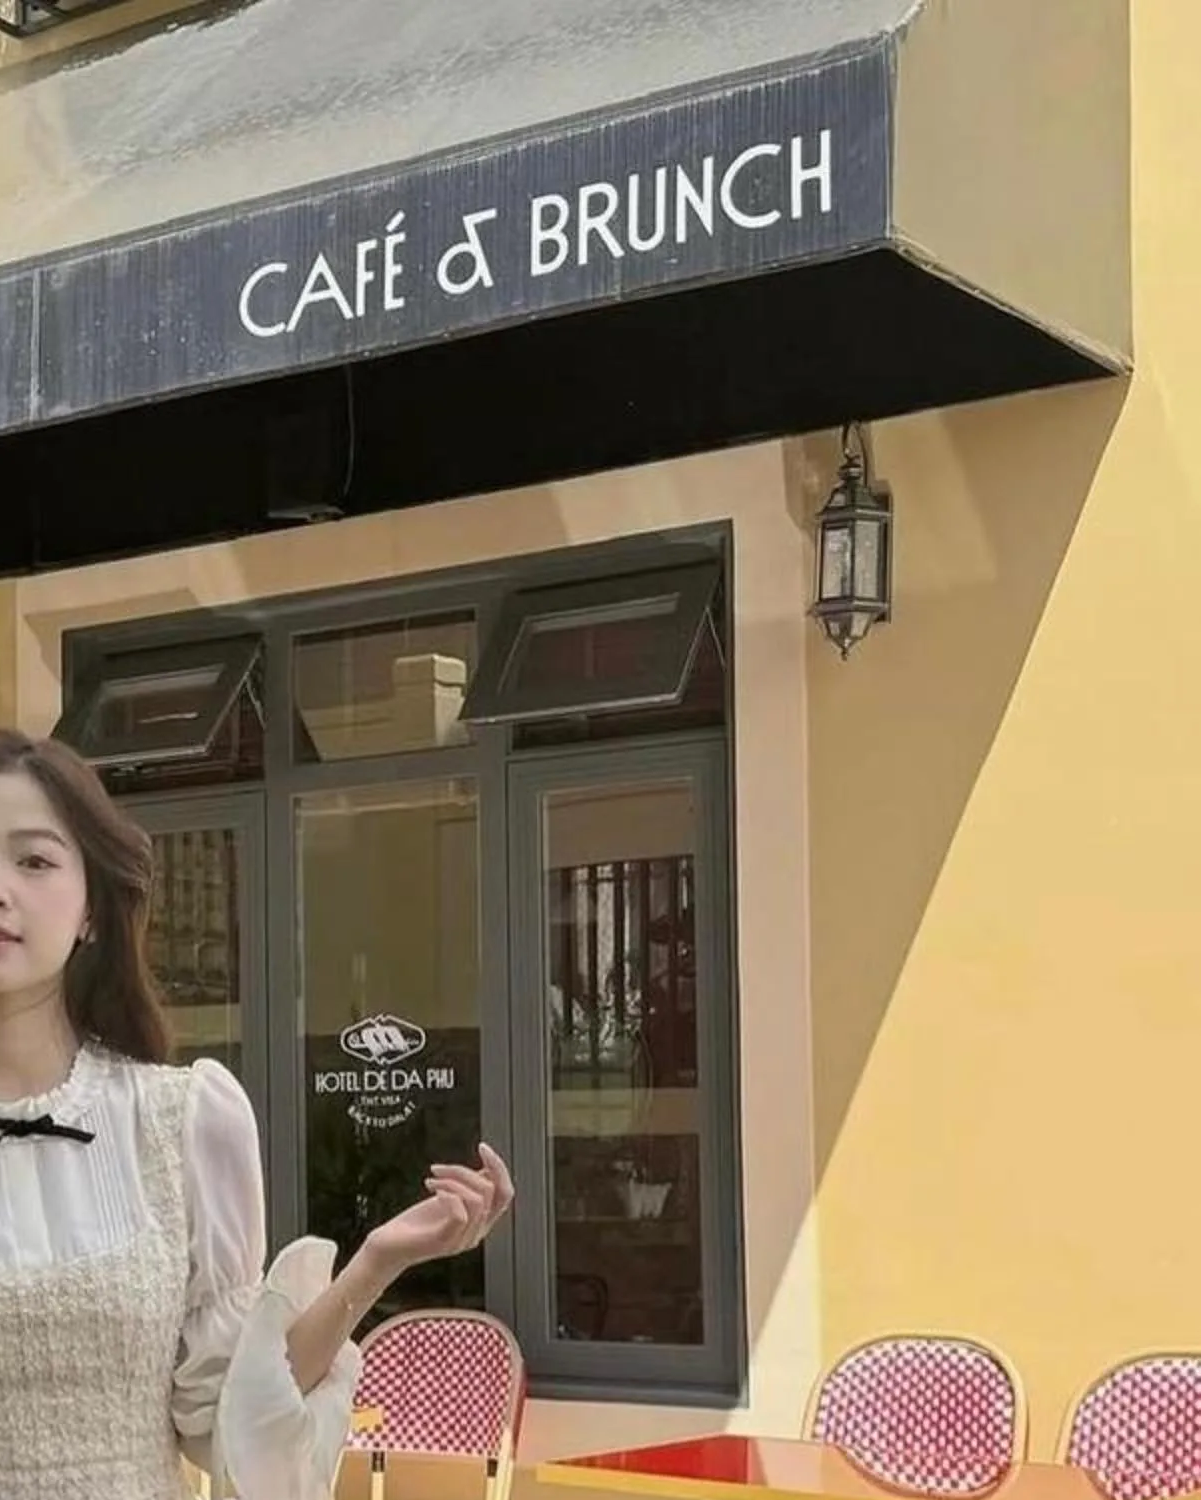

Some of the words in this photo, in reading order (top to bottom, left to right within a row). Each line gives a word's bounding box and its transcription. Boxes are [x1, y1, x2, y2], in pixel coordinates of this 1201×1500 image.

[239, 211, 406, 338] CAFÉ
[437, 208, 498, 295] &
[530, 129, 832, 278] BRUNCH
[364, 1069, 388, 1091] DE
[391, 1069, 423, 1091] DA
[426, 1068, 455, 1089] PHU
